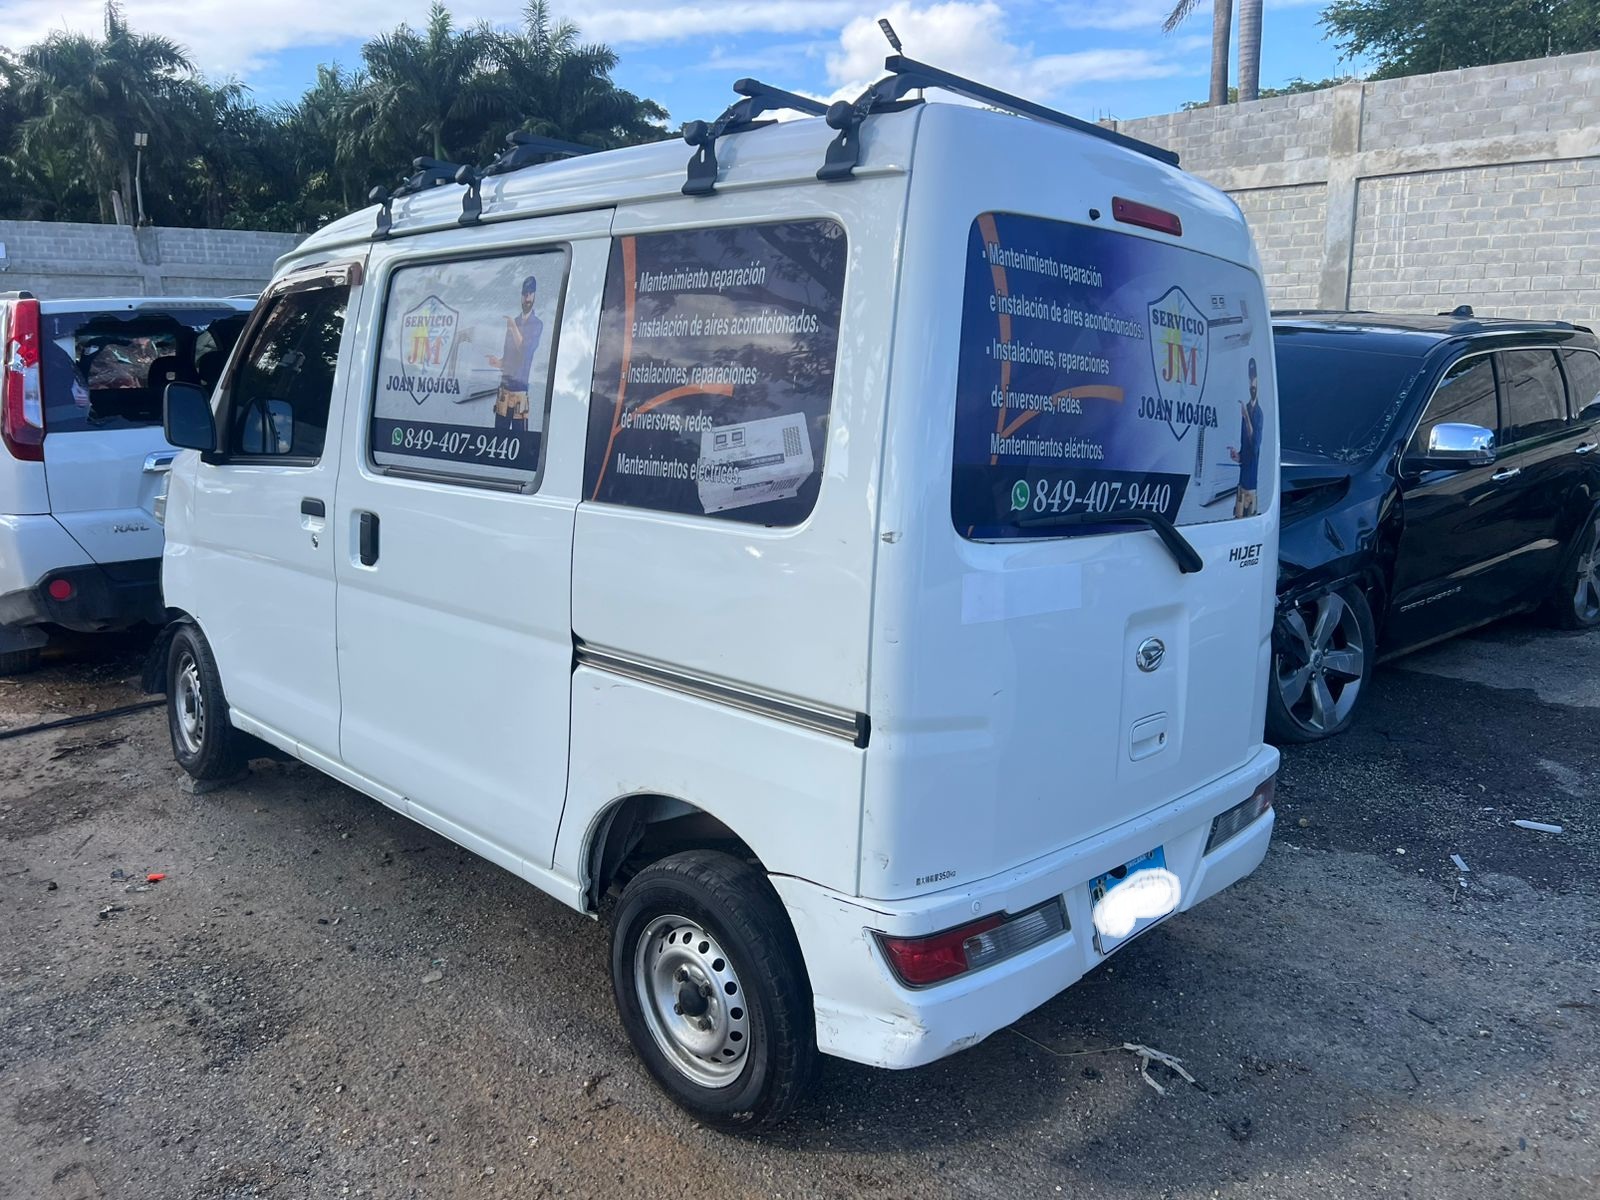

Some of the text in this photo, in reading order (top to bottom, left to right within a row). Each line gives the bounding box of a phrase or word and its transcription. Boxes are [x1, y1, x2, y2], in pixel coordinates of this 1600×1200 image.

[639, 260, 766, 293] Mantenimiento reparación
[988, 243, 1103, 288] Mantenimiento reparación
[405, 315, 453, 328] SERVICIO
[632, 308, 819, 338] e instalación de aires acondicionados.
[989, 289, 1145, 340] e instalación de aires acondicionados.
[1152, 308, 1205, 336] SERVICIO
[408, 336, 443, 365] JM
[993, 338, 1110, 375] Instalaciones, reparaciones
[1162, 342, 1198, 386] JM
[386, 375, 461, 395] JOAN MOJICA
[627, 360, 758, 389] Instalaciones, reparaciones
[991, 384, 1083, 415] de inversores, redes.
[1138, 396, 1218, 428] JOAN MOJICA
[620, 408, 633, 429] de
[633, 408, 683, 435] inversores,
[404, 428, 520, 461] 849-407-9440
[990, 432, 1105, 460] Mantenimientos eléctricos.
[616, 453, 689, 480] Mantenimientos
[1033, 478, 1171, 514] 849-407-9440
[1229, 543, 1263, 562] HIJET
